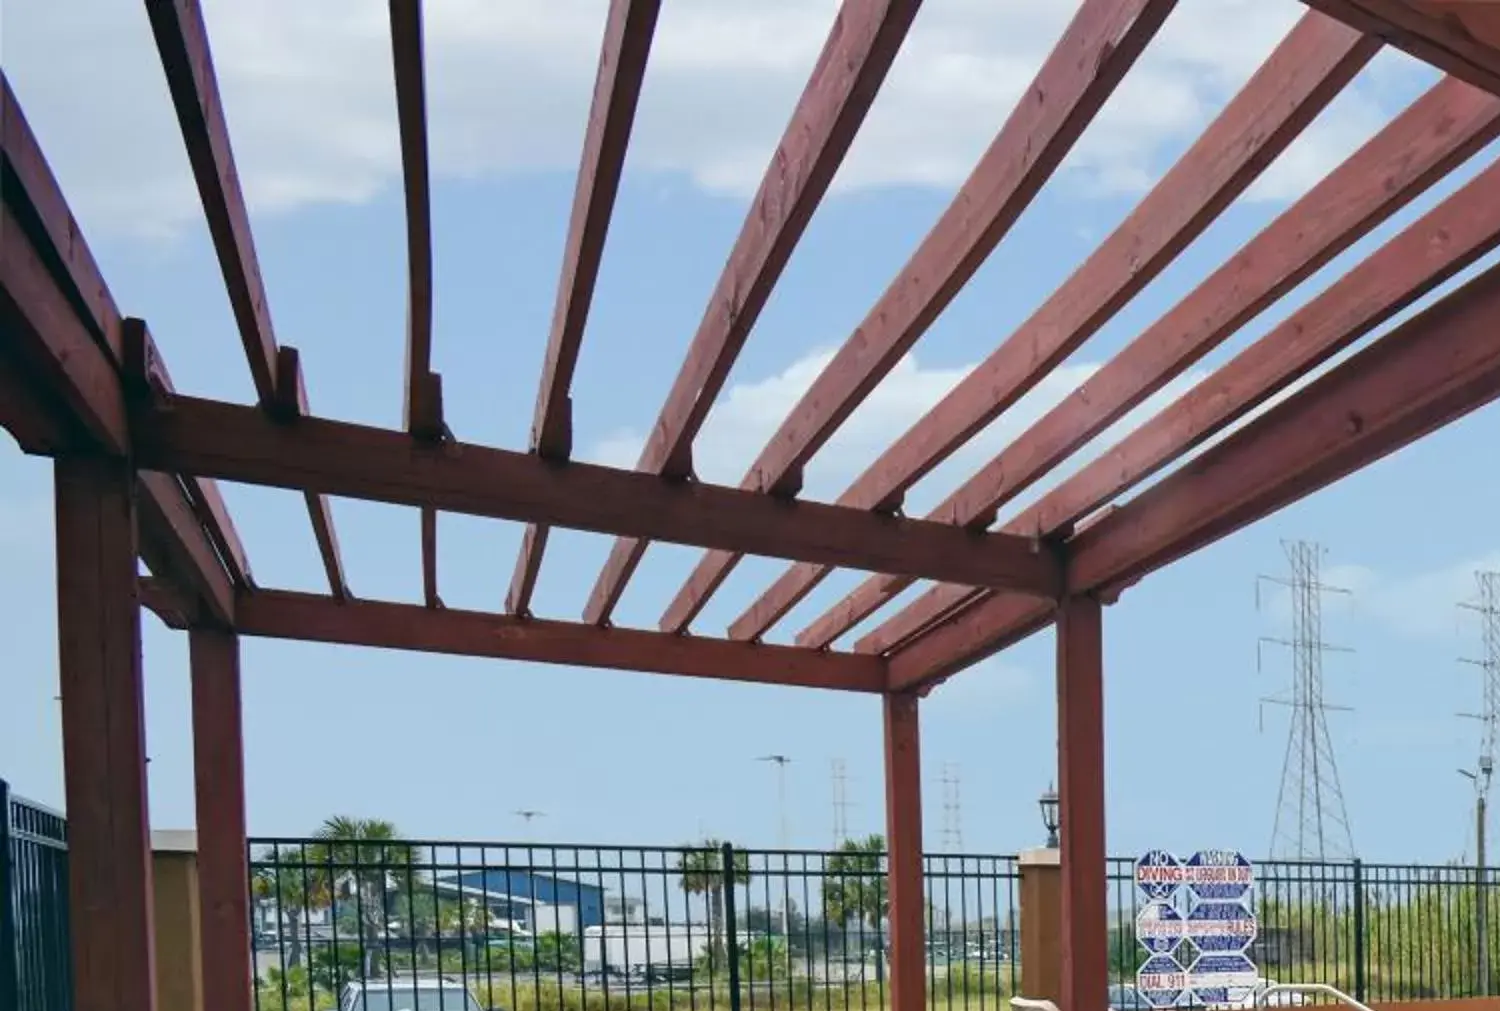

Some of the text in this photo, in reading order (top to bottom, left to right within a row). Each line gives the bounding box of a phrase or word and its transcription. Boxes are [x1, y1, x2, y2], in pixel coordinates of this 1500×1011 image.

[1149, 851, 1168, 866] NO
[1138, 867, 1182, 881] DIVING
[1167, 974, 1185, 988] 911
